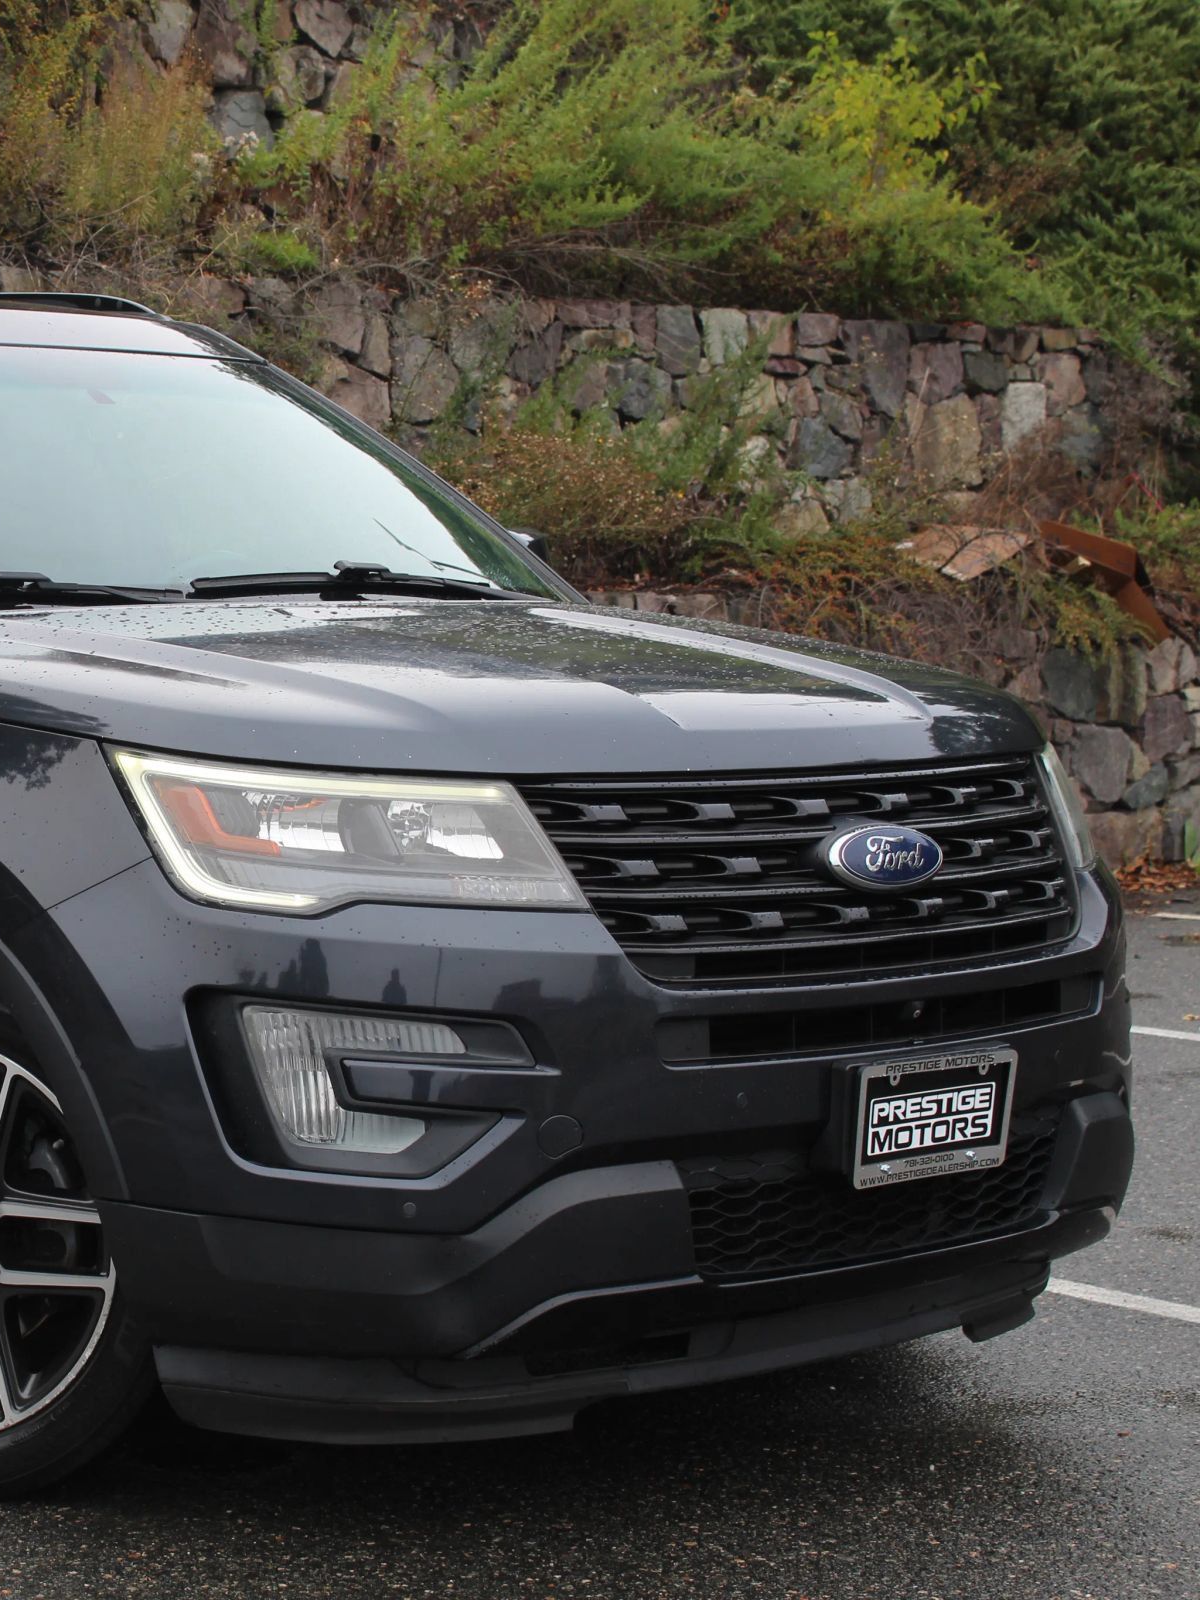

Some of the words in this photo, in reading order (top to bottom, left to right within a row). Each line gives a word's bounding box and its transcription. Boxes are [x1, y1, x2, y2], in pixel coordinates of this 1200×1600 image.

[866, 835, 924, 872] Ford
[886, 1060, 941, 1075] PRESTIGE
[945, 1054, 995, 1068] MOTORS
[873, 1087, 991, 1125] PRESTIGE
[871, 1114, 989, 1153] MOTORS
[860, 1158, 1000, 1187] WWW.PRESTIGEDEALERSHIP.COM
[904, 1153, 955, 1168] 781-321-0100
